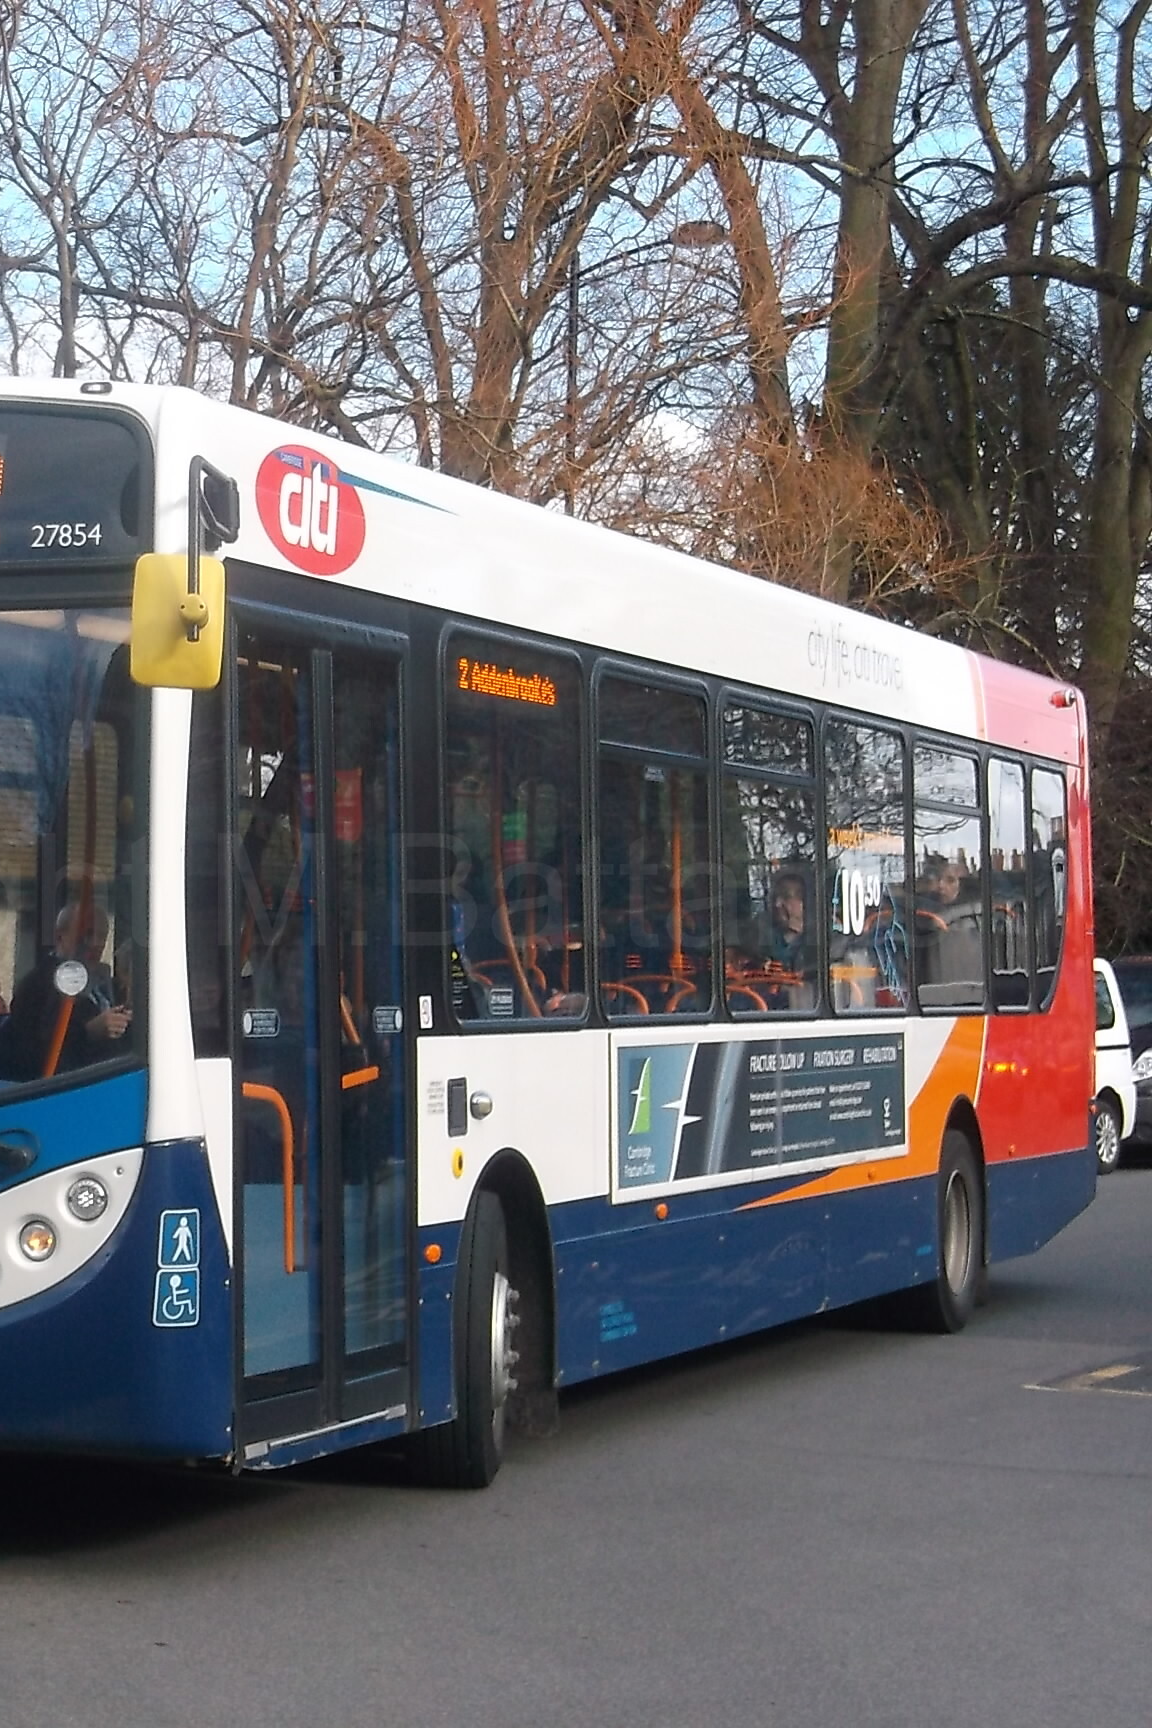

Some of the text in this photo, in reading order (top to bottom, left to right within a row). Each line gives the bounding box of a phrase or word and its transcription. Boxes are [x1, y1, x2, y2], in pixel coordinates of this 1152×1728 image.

[279, 462, 339, 555] citi
[30, 523, 102, 548] 27854
[458, 658, 469, 689] 2
